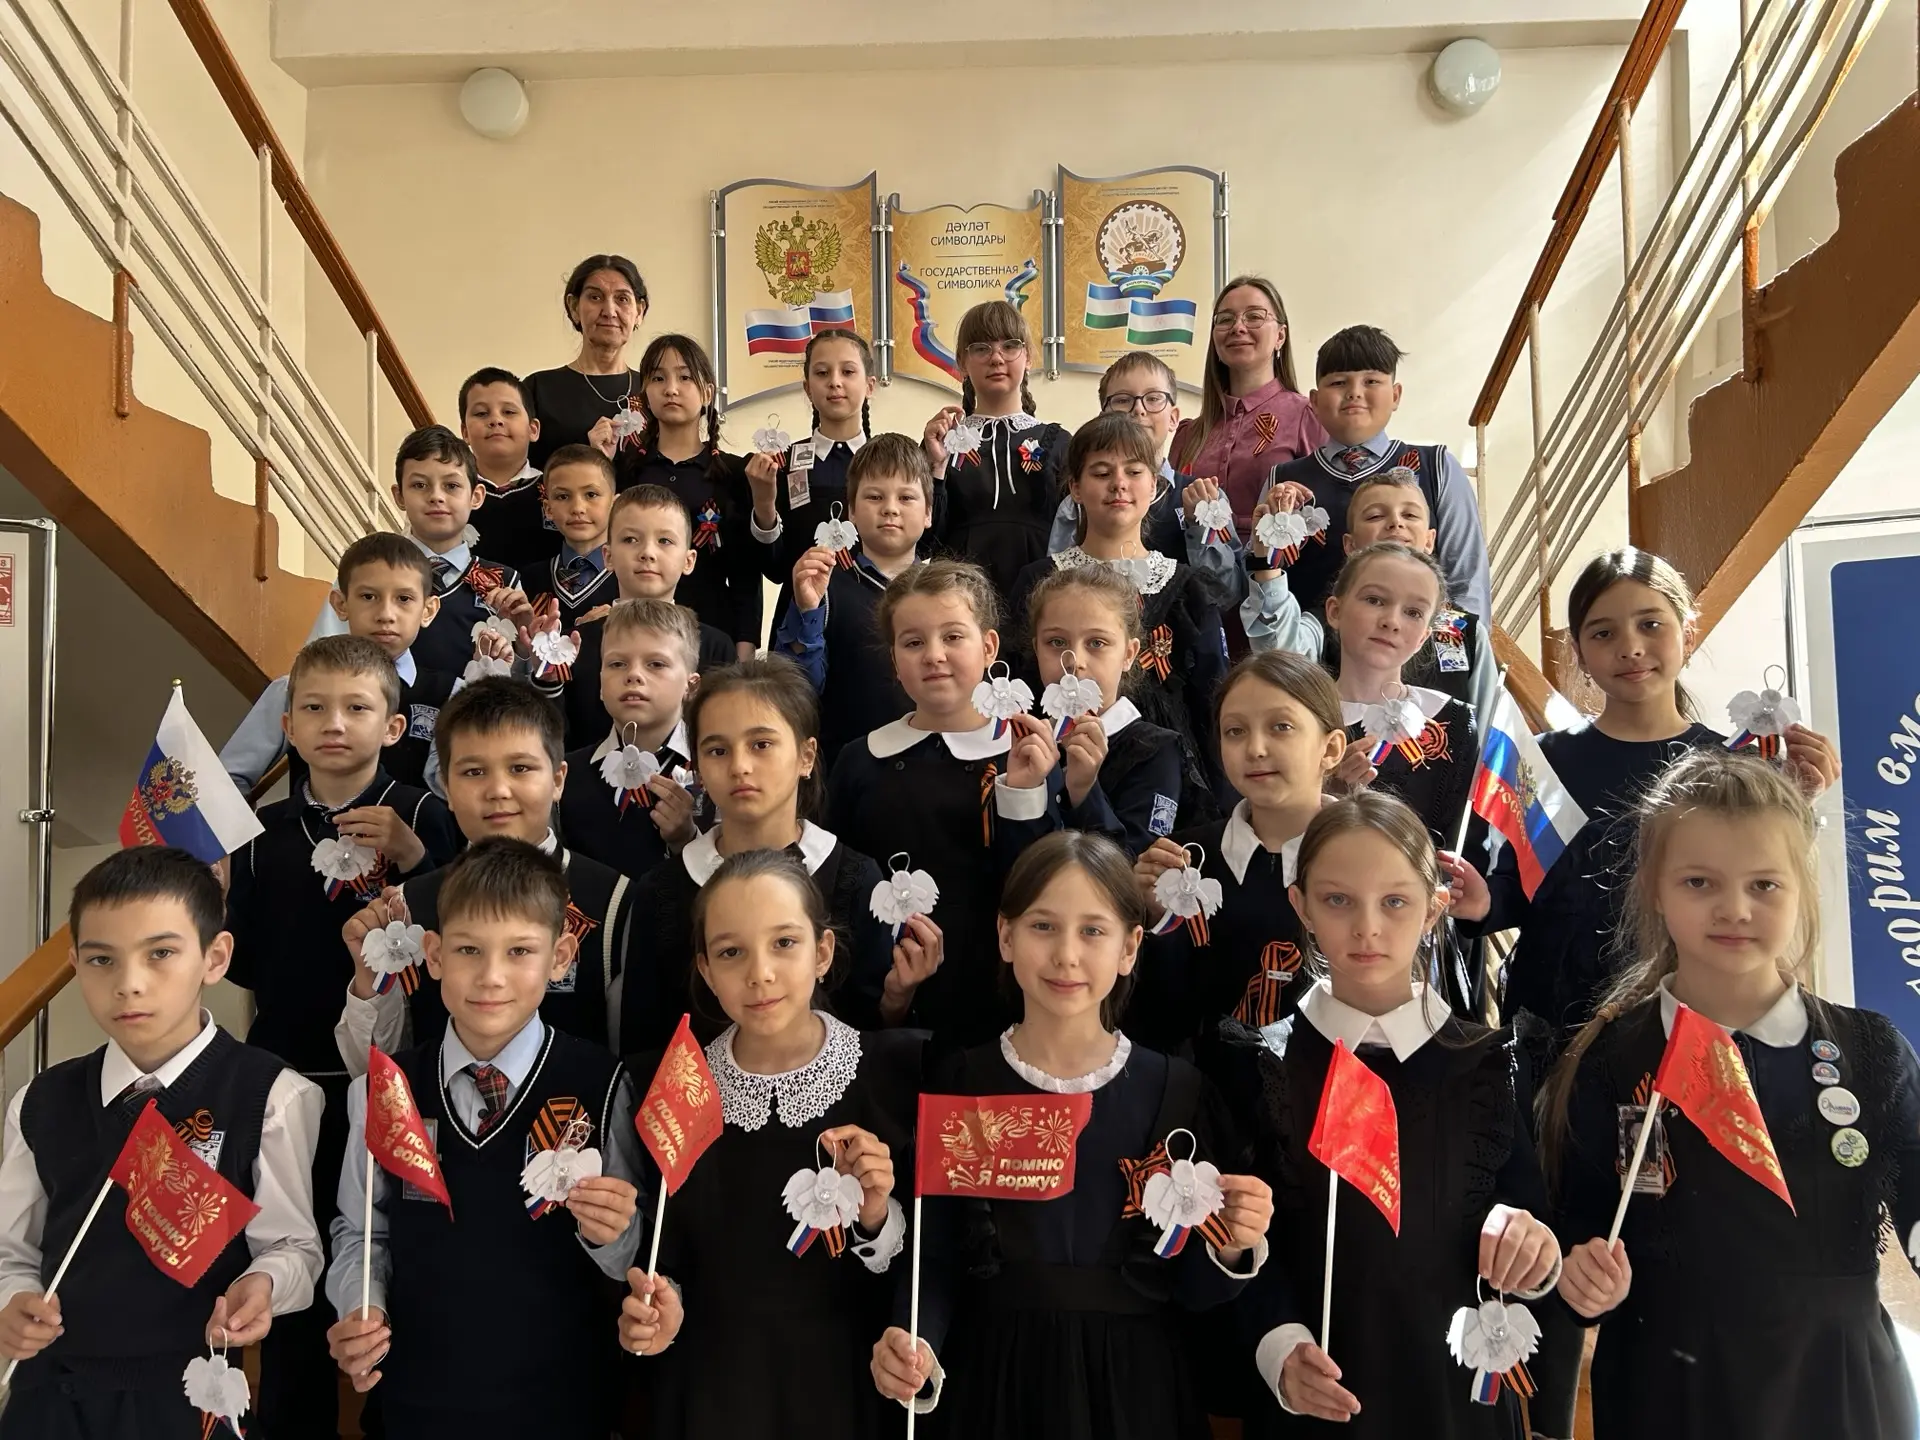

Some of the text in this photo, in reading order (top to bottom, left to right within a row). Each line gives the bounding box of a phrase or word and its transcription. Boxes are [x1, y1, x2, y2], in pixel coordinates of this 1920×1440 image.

[946, 222, 990, 233] ДӘҮЛӘТ
[931, 235, 1006, 246] СИМВОЛДАРЫ
[920, 265, 1018, 277] ГОСУДАРСТВЕННАЯ
[937, 279, 1001, 289] СИМВОЛИКА
[129, 791, 156, 845] ССИЯ
[1866, 692, 1920, 996] ворим вм
[976, 1170, 1061, 1192] Я горжус
